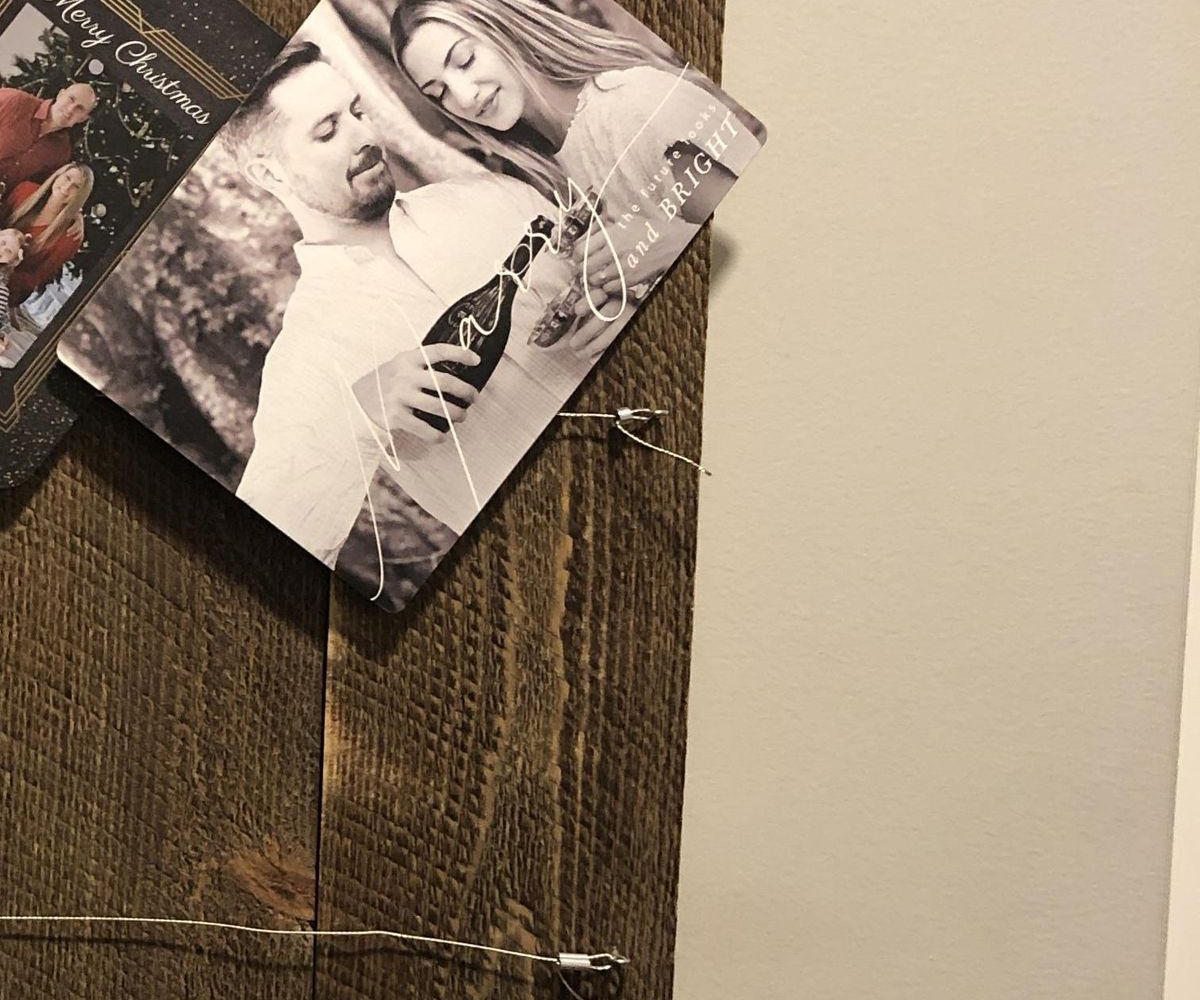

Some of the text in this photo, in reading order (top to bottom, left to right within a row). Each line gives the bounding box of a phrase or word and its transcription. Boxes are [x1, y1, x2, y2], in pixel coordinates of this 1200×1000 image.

[114, 40, 210, 126] Christmas
[617, 104, 717, 230] the future looks
[627, 111, 739, 269] and BRIGHT
